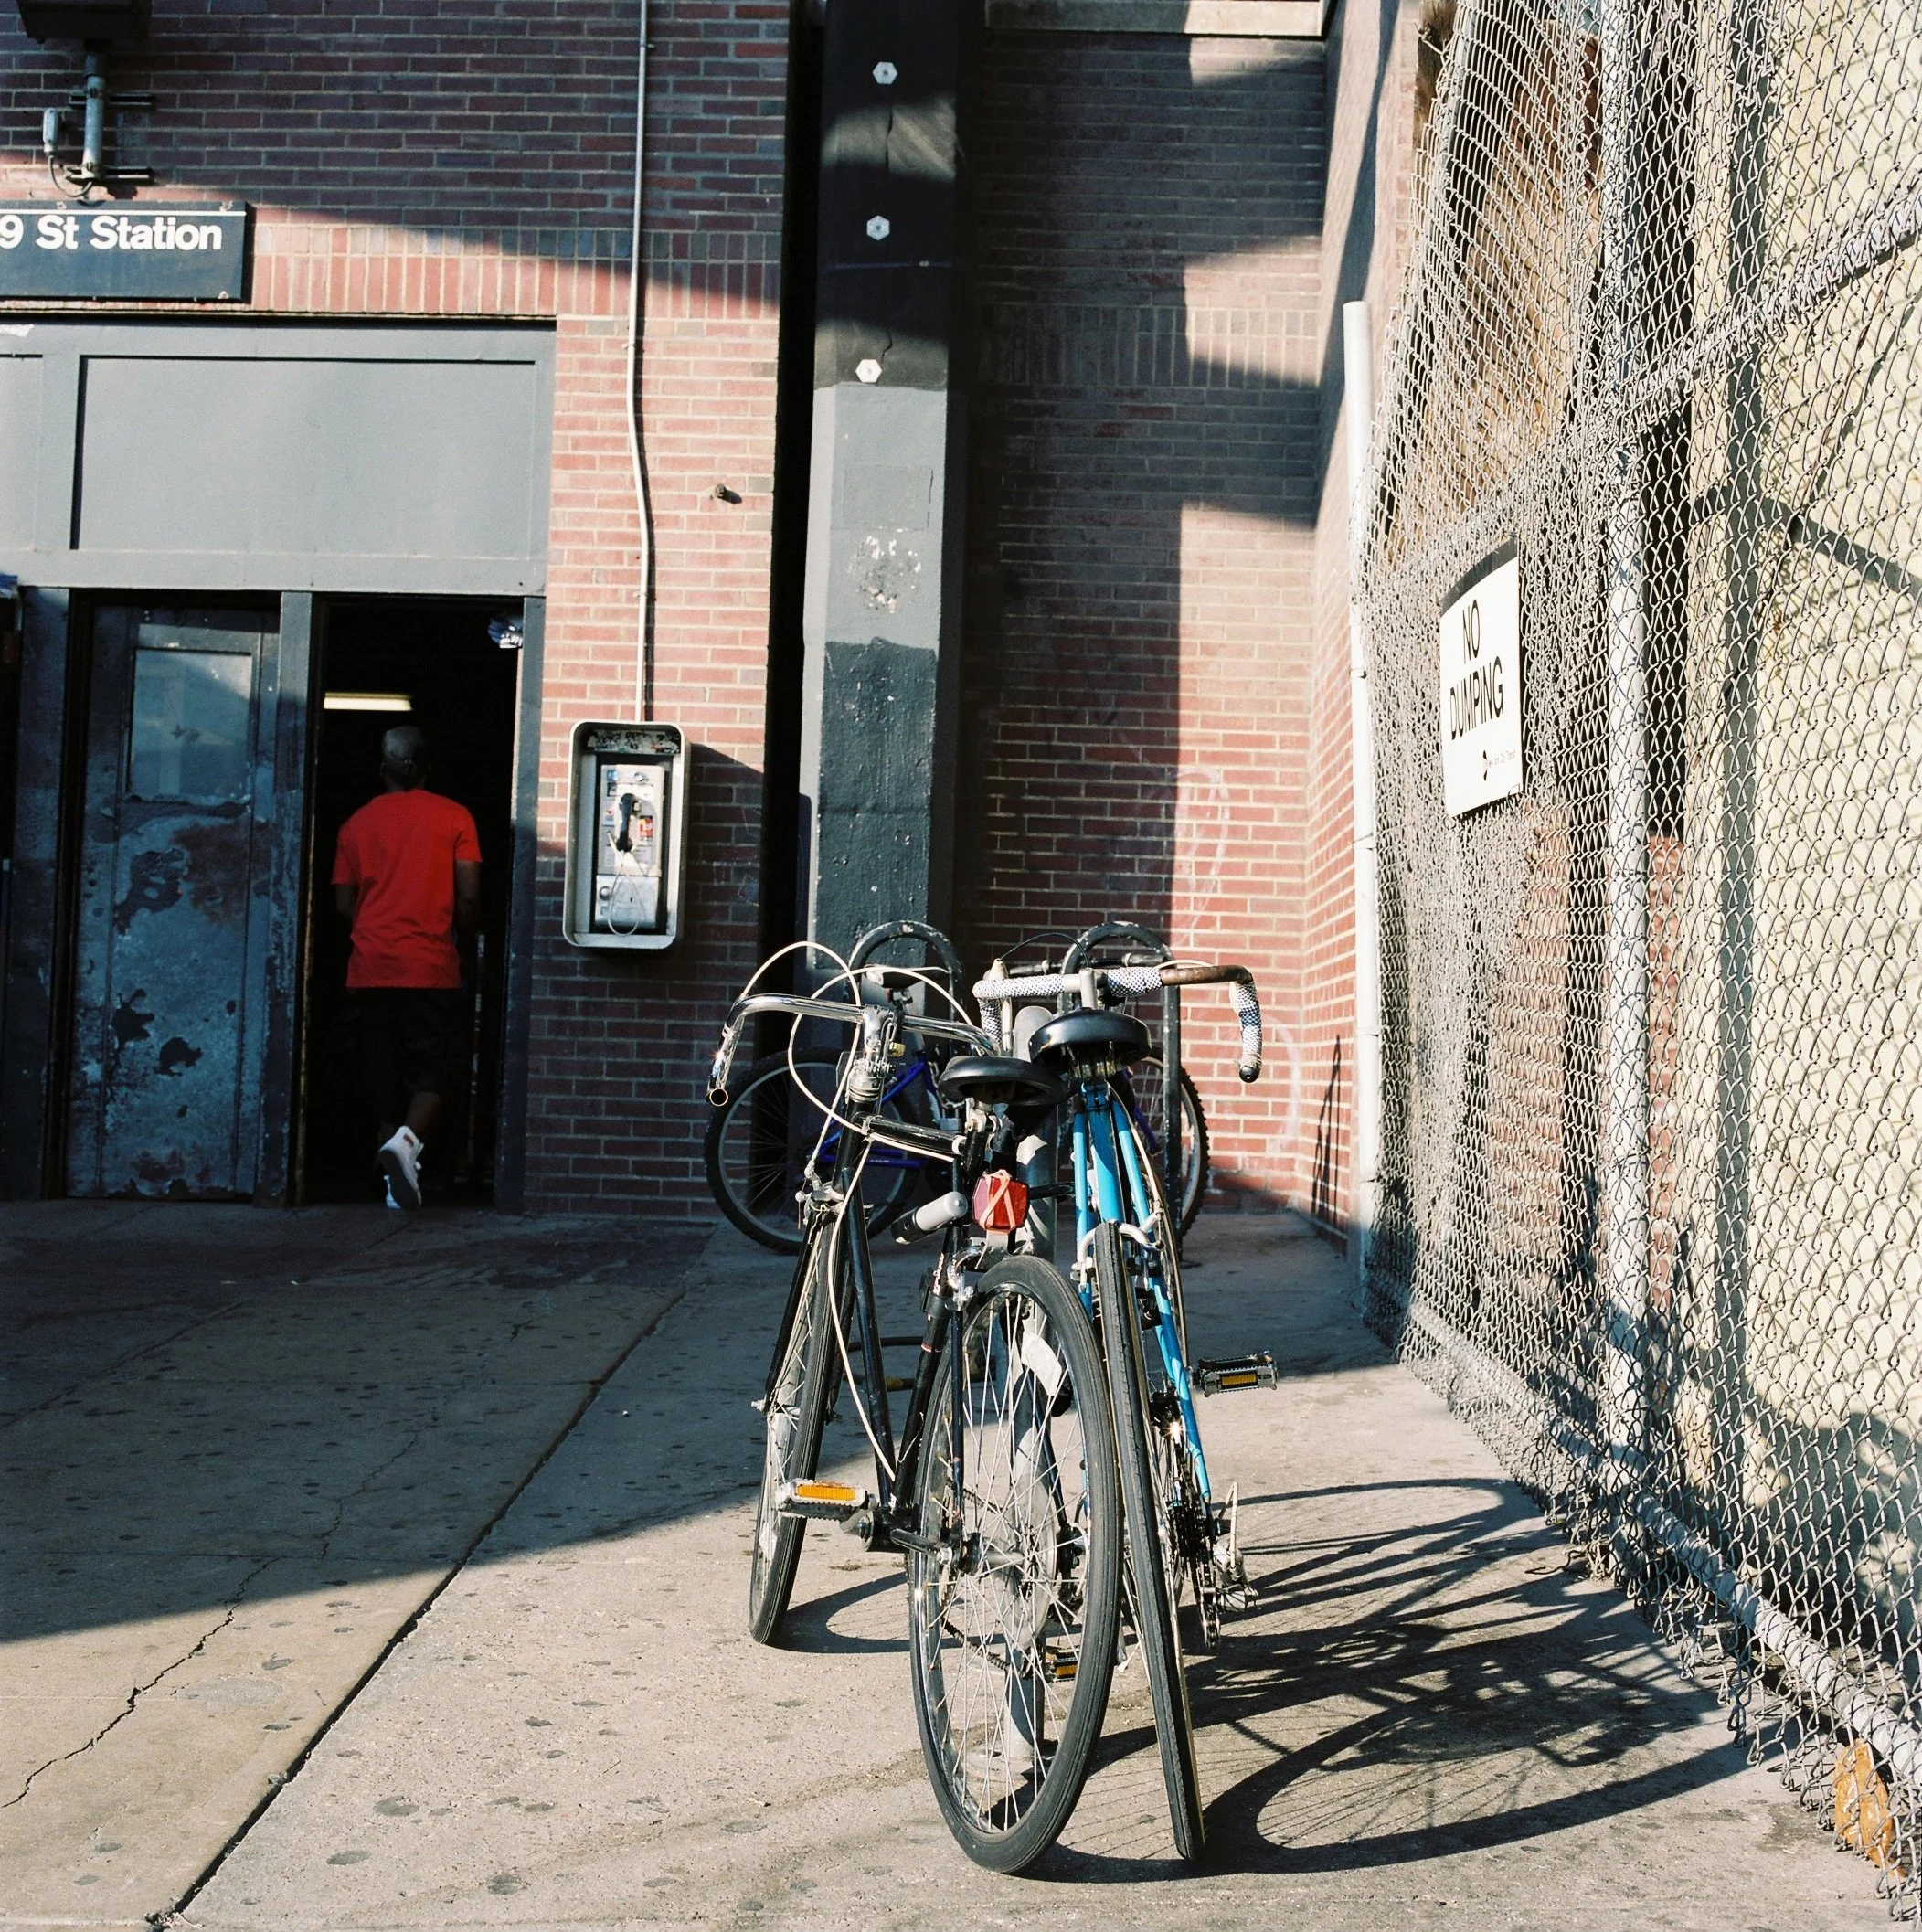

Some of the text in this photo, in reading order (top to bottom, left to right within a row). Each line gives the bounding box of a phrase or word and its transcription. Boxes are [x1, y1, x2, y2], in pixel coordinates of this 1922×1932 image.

[36, 214, 79, 249] St
[90, 214, 222, 250] Station
[1462, 599, 1480, 663] NO
[1450, 656, 1503, 740] DUMPING
